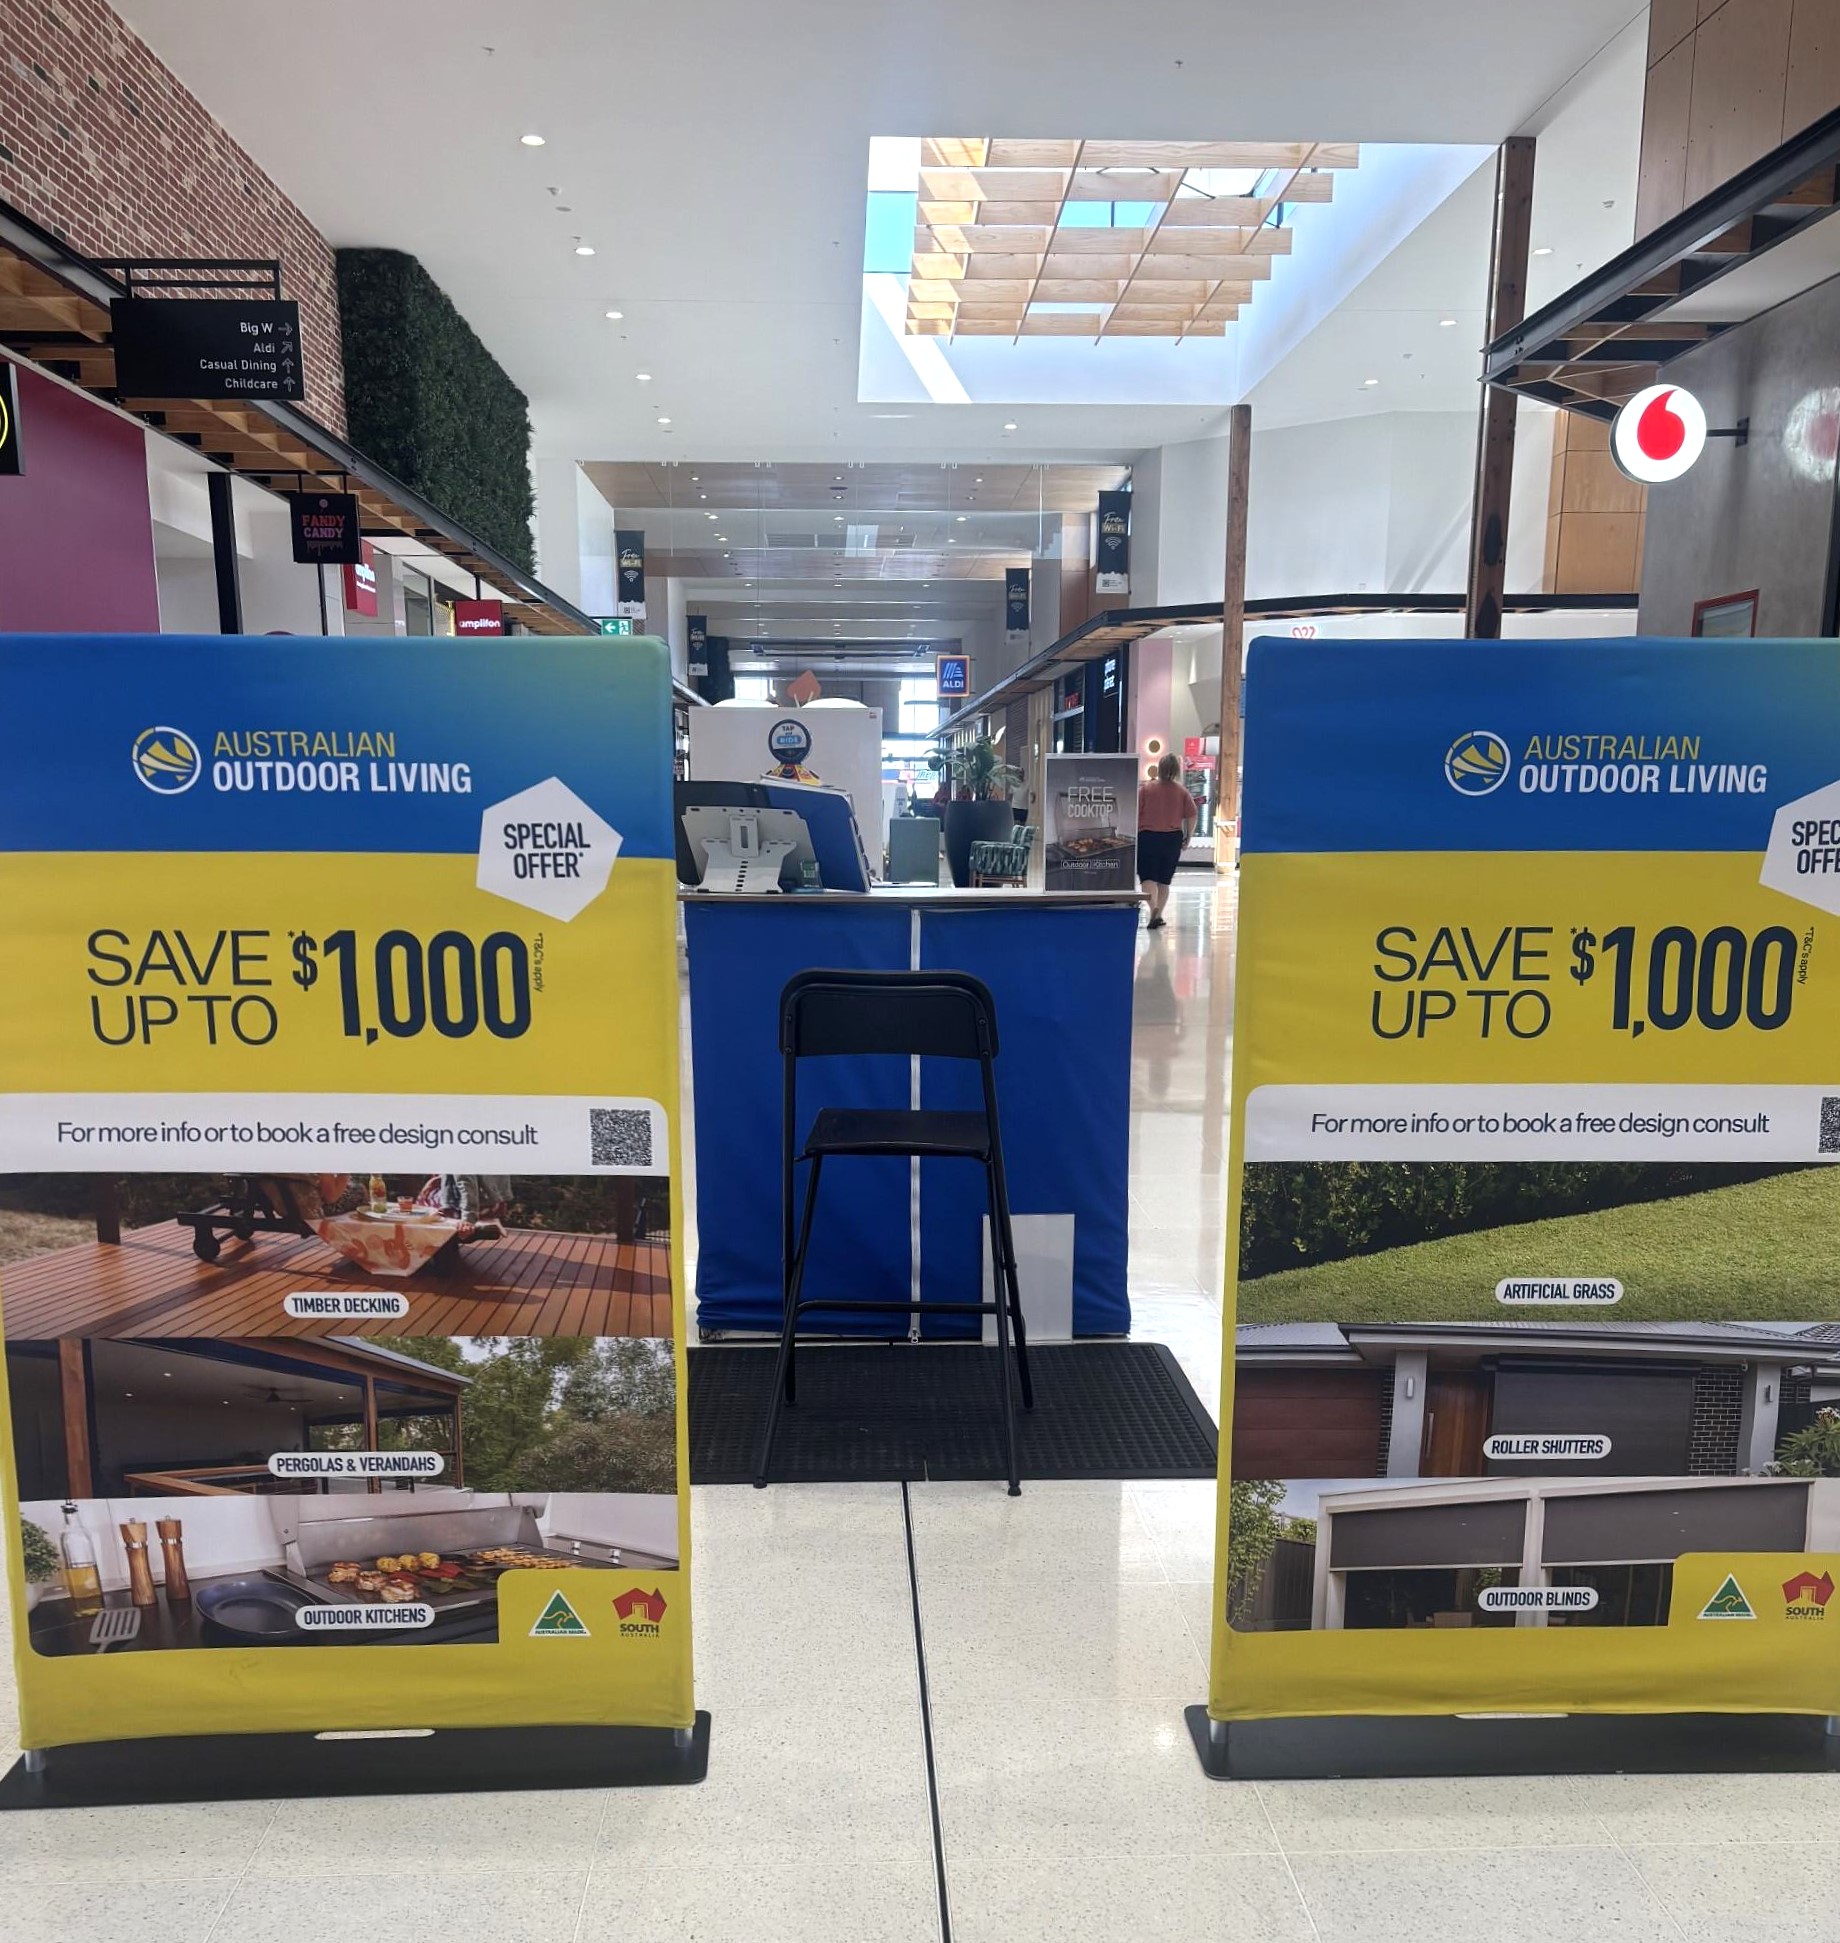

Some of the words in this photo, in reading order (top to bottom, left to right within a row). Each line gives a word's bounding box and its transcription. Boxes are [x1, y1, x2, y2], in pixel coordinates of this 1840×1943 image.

[240, 322, 259, 336] Big
[261, 322, 273, 333] W
[253, 342, 275, 353] Aldi
[200, 359, 238, 370] Casual
[241, 359, 277, 373] Dining
[225, 378, 278, 389] Childcare
[304, 527, 344, 538] CANDY
[459, 618, 501, 629] amplifon
[214, 732, 396, 757] AUSTRALIAN
[1524, 735, 1700, 760] AUSTRALIAN
[213, 761, 360, 792] OUTDOOR
[370, 762, 472, 794] LIVING
[1519, 765, 1659, 793] OUTDOOR
[1668, 765, 1767, 793] LIVING
[1068, 786, 1115, 802] FREE
[1068, 804, 1114, 818] COOKTOP
[503, 822, 591, 849] SPECIAL
[1791, 820, 1840, 846] SPEC
[87, 929, 272, 987] SAVE
[1373, 926, 1553, 983] SAVE
[1797, 959, 1808, 985] apply
[91, 995, 179, 1046] UP
[186, 995, 278, 1045] TO
[1371, 990, 1457, 1039] UP
[1467, 990, 1551, 1039] TO
[1311, 1113, 1348, 1133] For
[1350, 1117, 1408, 1133] more
[1411, 1112, 1450, 1133] info
[1452, 1117, 1476, 1133] or
[1477, 1115, 1500, 1133] to
[1503, 1112, 1556, 1133] book
[1559, 1117, 1572, 1133] a
[1575, 1112, 1616, 1133] free
[1618, 1112, 1690, 1138] design
[1692, 1112, 1770, 1133] consult
[58, 1122, 95, 1142] For
[99, 1126, 158, 1142] more
[161, 1121, 201, 1142] info
[204, 1127, 228, 1142] or
[230, 1124, 253, 1143] to
[257, 1121, 313, 1143] book
[316, 1127, 330, 1143] a
[333, 1122, 376, 1144] free
[379, 1123, 454, 1149] design
[458, 1124, 539, 1145] consult
[1503, 1283, 1570, 1300] ARTIFICIAL
[1573, 1282, 1615, 1300] GRASS
[292, 1297, 342, 1313] TIMBER
[344, 1298, 400, 1313] DECKING
[1491, 1440, 1539, 1455] ROLLER
[1541, 1439, 1604, 1455] SHUTTERS
[277, 1458, 343, 1472] PERGOLAS
[347, 1459, 356, 1471] &
[360, 1457, 436, 1471] VERANDAHS
[1486, 1592, 1543, 1607] OUTDOOR
[1546, 1591, 1590, 1607] BLINDS
[304, 1608, 362, 1626] OUTDOOR
[365, 1607, 426, 1625] KITCHENS
[1786, 1607, 1824, 1616] SOUTH
[620, 1624, 659, 1633] SOUTH
